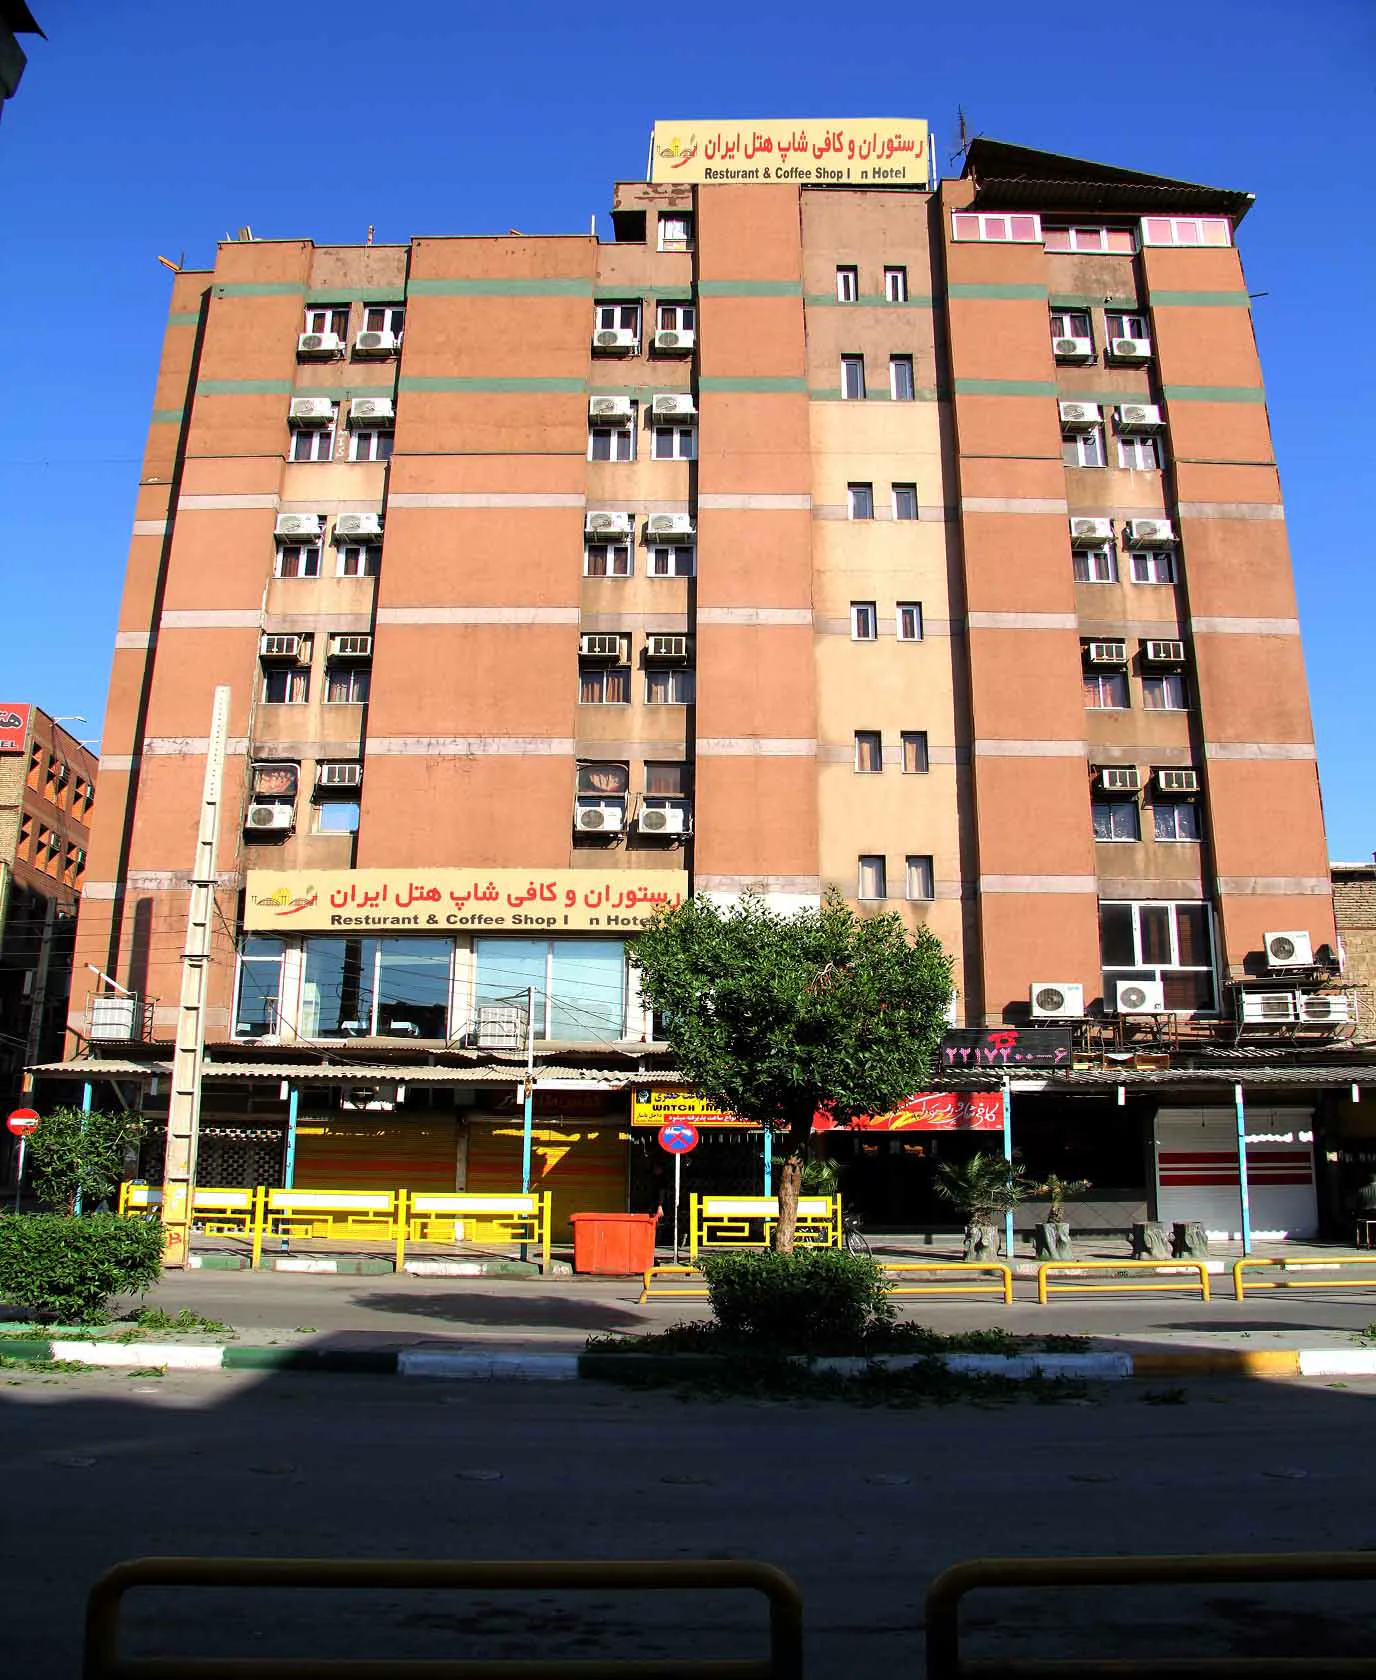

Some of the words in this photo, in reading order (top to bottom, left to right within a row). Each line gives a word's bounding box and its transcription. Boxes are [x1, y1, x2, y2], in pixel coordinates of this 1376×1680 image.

[704, 132, 740, 160] ایران
[744, 132, 773, 160] هتل
[778, 129, 808, 163] شاپ
[813, 130, 844, 160] کافی
[848, 139, 855, 160] و
[859, 132, 924, 160] رستوران
[704, 167, 759, 179] Resturant
[763, 167, 771, 179] &
[775, 167, 812, 179] Coffee
[815, 166, 843, 182] Shop
[872, 166, 906, 179] Hotel
[330, 883, 388, 908] ایران
[395, 882, 442, 908] هتل
[450, 881, 499, 911] شاپ
[507, 881, 557, 907] کافی
[564, 888, 577, 909] و
[584, 884, 681, 909] رستوران
[331, 913, 420, 926] Resturant
[427, 913, 439, 926] &
[445, 913, 505, 926] Coffee
[511, 913, 557, 928] Shop
[606, 914, 657, 925] Hote
